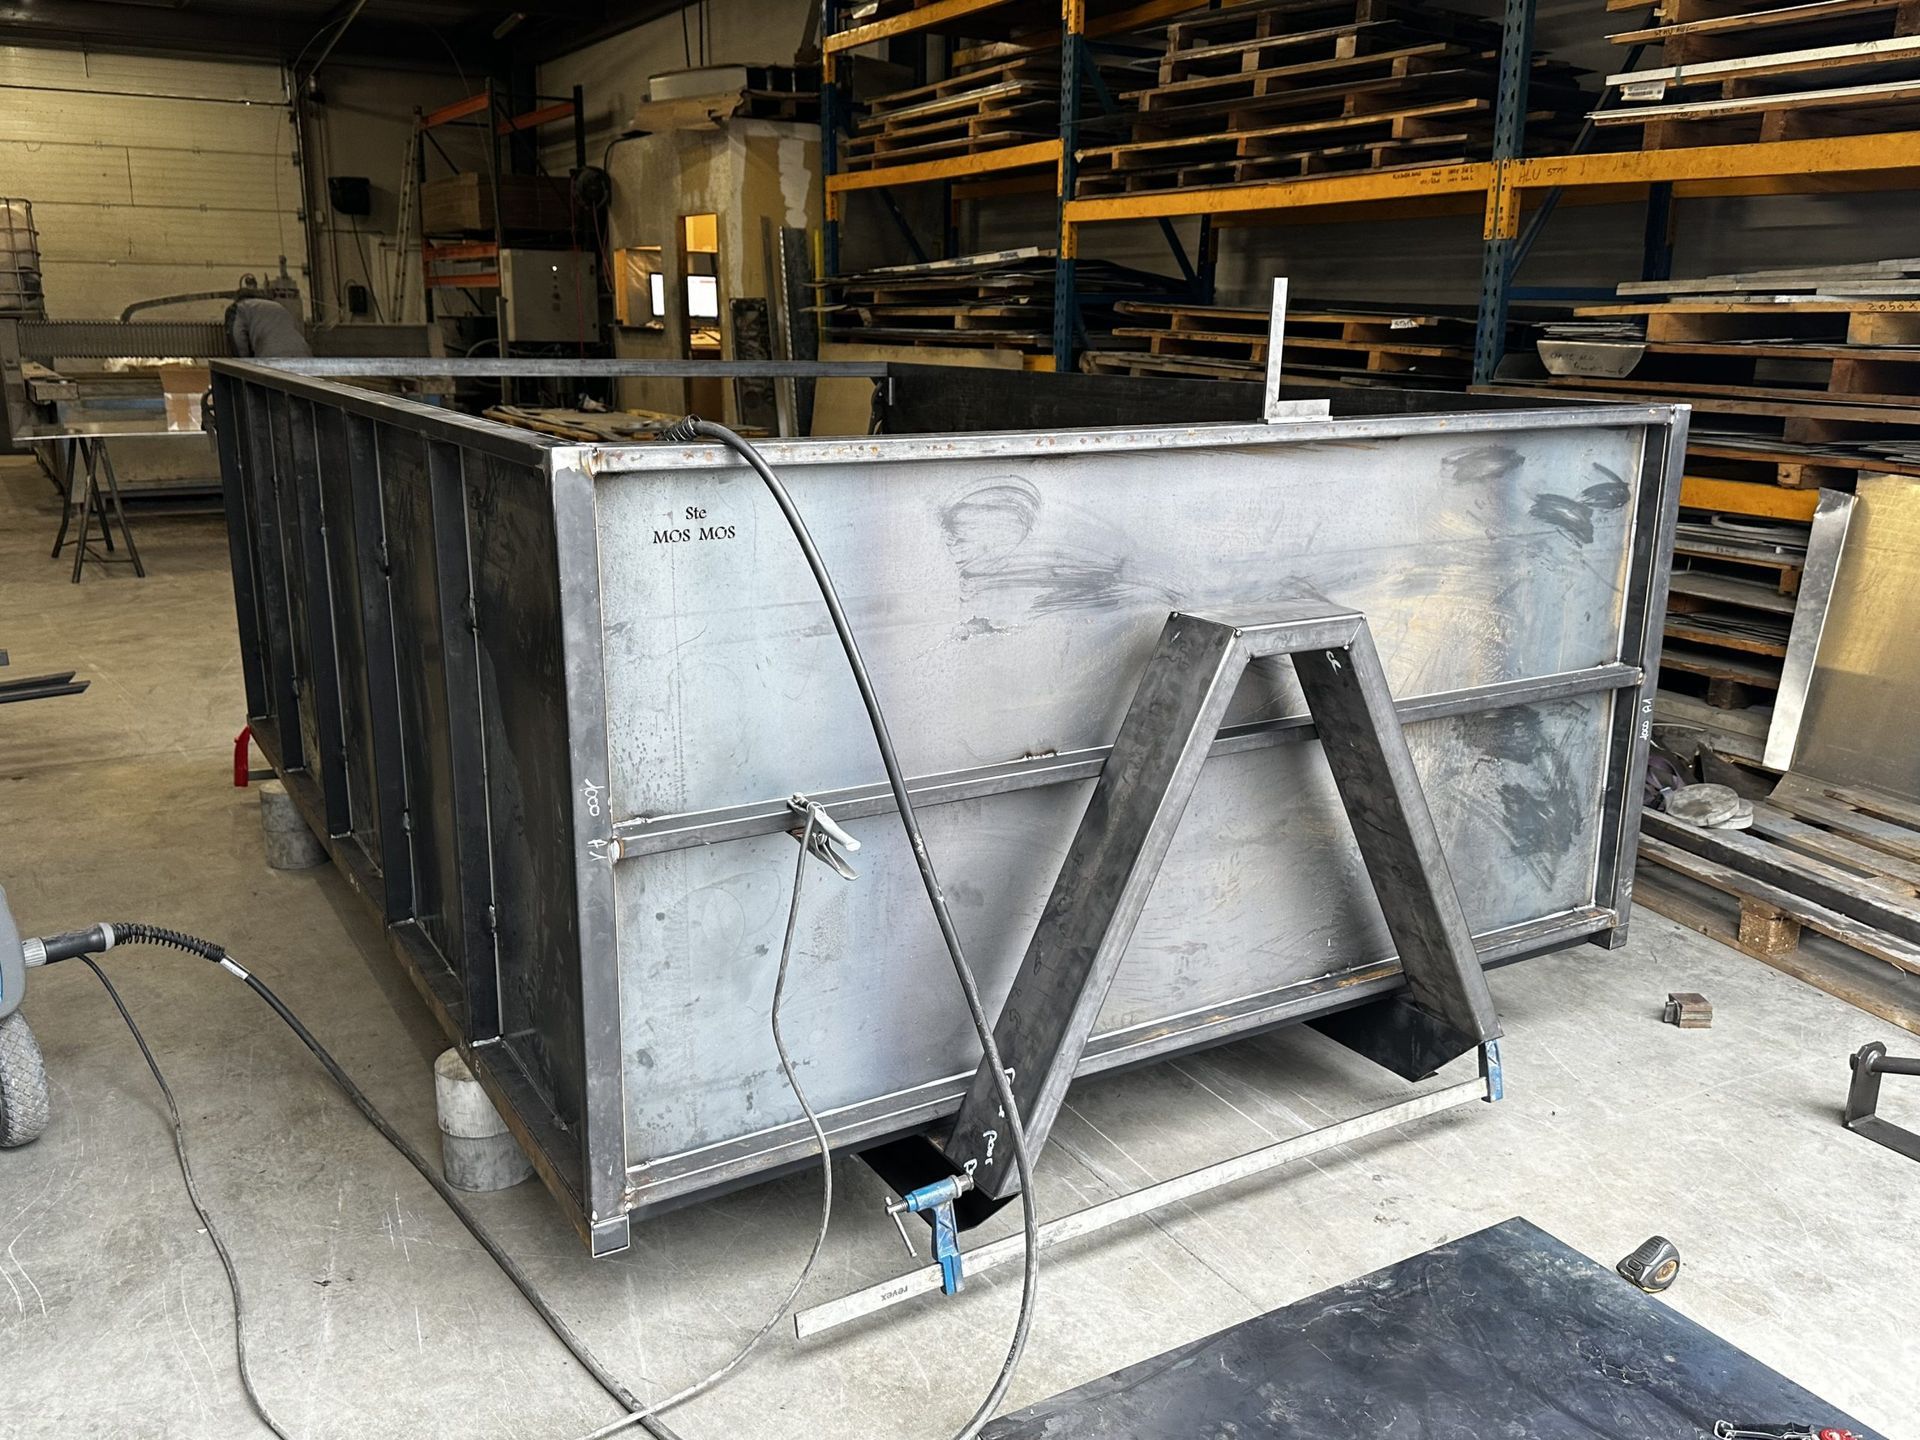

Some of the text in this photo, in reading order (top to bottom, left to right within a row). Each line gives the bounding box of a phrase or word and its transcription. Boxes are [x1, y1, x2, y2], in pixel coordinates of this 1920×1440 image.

[1867, 302, 1904, 311] 2050
[653, 525, 736, 544] MOS MOS
[1642, 698, 1653, 713] A1
[881, 1285, 908, 1302] revex
